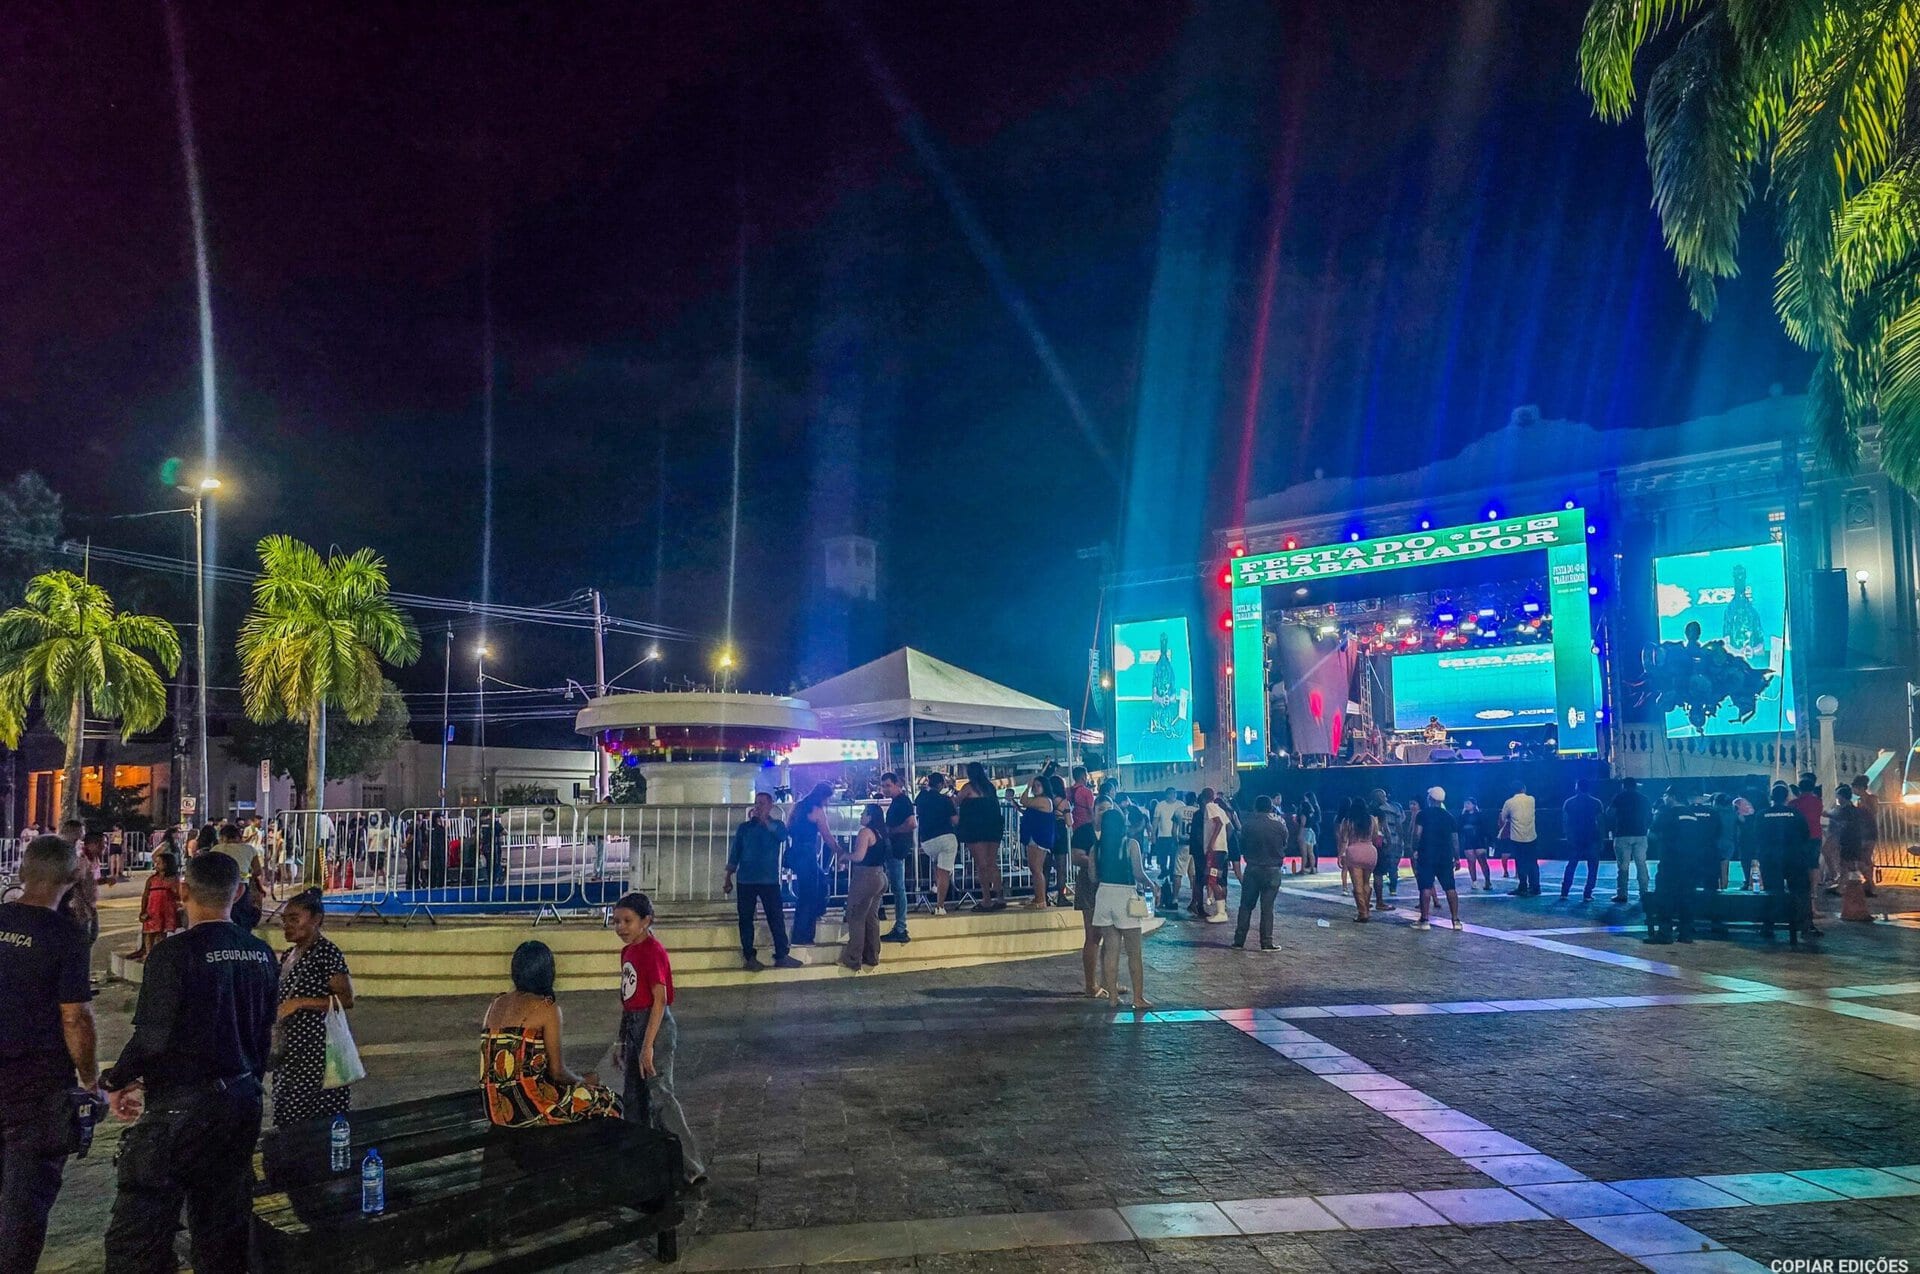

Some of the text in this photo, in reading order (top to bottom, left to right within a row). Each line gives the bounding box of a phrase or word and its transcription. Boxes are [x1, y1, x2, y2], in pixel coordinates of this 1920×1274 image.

[1240, 535, 1436, 574] FESTA DO
[1240, 530, 1559, 584] TRABALHADOR
[205, 949, 269, 963] SEGURANÇA
